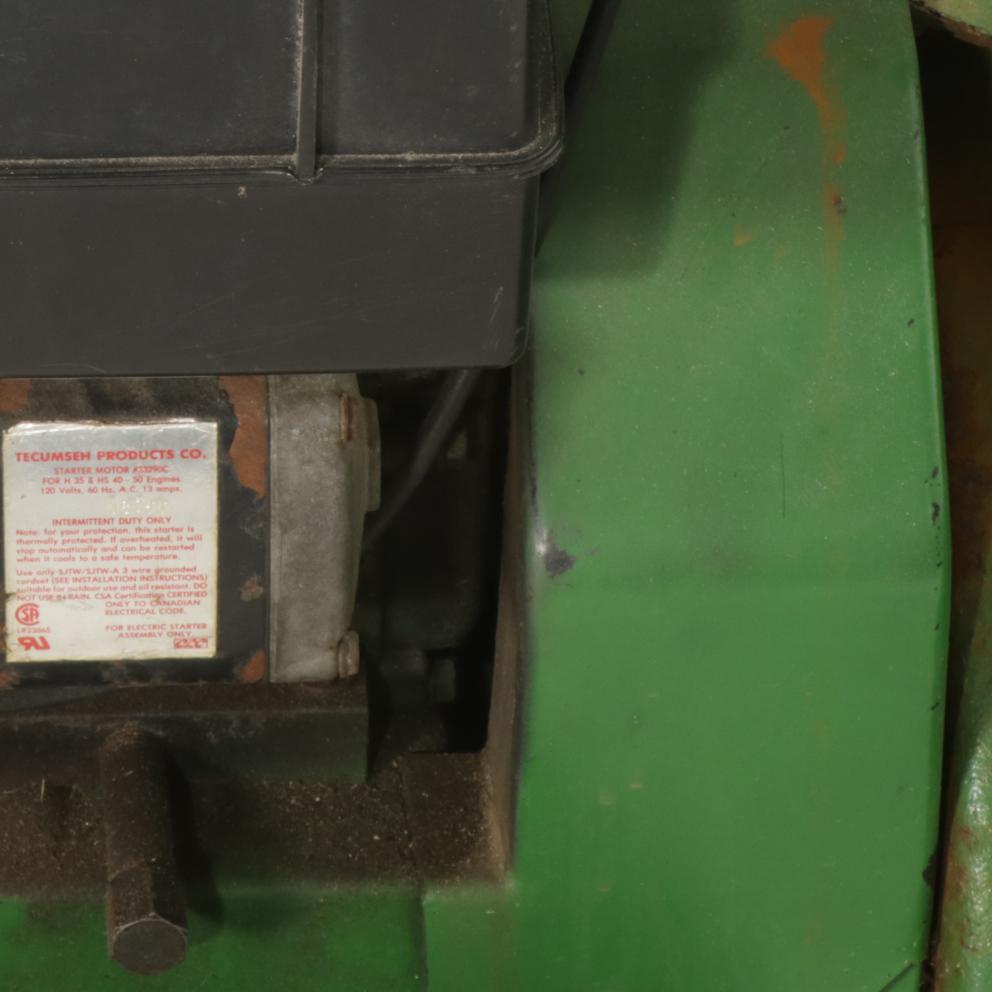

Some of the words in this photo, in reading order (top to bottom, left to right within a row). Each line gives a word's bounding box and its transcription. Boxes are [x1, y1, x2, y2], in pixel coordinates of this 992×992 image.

[15, 450, 91, 463] TECUMSEH
[96, 449, 175, 461] PRODUCTS
[179, 448, 207, 460] CO.
[53, 466, 93, 475] STARTER
[95, 466, 129, 474] MOTOR
[41, 477, 60, 485] FOR
[63, 477, 71, 485] H
[52, 517, 114, 526] INTERMITTENT
[118, 516, 143, 525] DUTY
[145, 516, 172, 525] ONLY
[154, 526, 184, 534] starter
[16, 537, 58, 546] thermally
[38, 546, 98, 555] automatically
[36, 569, 55, 578] only
[154, 566, 197, 576] grounded
[72, 576, 137, 584] INSTALLATION
[67, 585, 101, 593] outdoor
[166, 591, 208, 599] CERTIFIED
[105, 600, 130, 608] ONLY
[150, 599, 201, 607] CANADIAN
[105, 608, 156, 616] ELECTRICAL
[117, 631, 163, 639] ASSEMBLY
